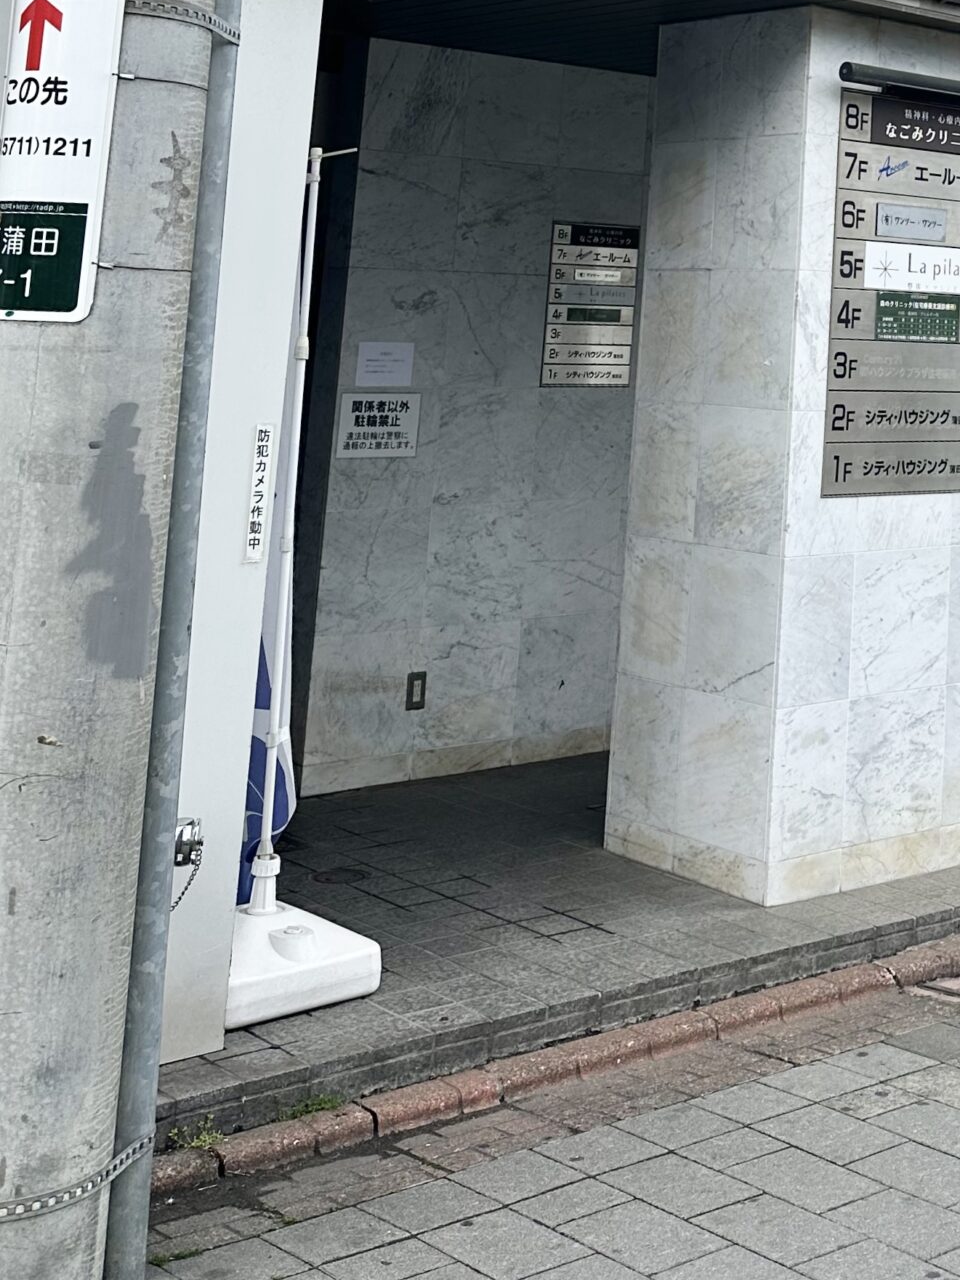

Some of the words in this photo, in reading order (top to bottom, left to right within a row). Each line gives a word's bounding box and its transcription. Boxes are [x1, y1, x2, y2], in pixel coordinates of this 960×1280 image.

[845, 103, 869, 130] 8F
[844, 151, 868, 180] 7F
[842, 200, 865, 229] 6F
[0, 225, 59, 256] 蒲田
[839, 250, 864, 279] 5F
[908, 252, 927, 273] La
[0, 269, 32, 298] -1
[837, 299, 861, 329] 4F
[833, 351, 858, 379] 3F
[351, 400, 410, 414] 関係者以外
[354, 414, 401, 428] 駐輪禁止
[831, 403, 855, 431] 2F
[865, 409, 951, 426] シティ・ハウジング
[833, 455, 853, 483] 1F
[862, 458, 949, 476] シティ・ハウジング
[248, 429, 271, 550] 防犯カメラ作動中
